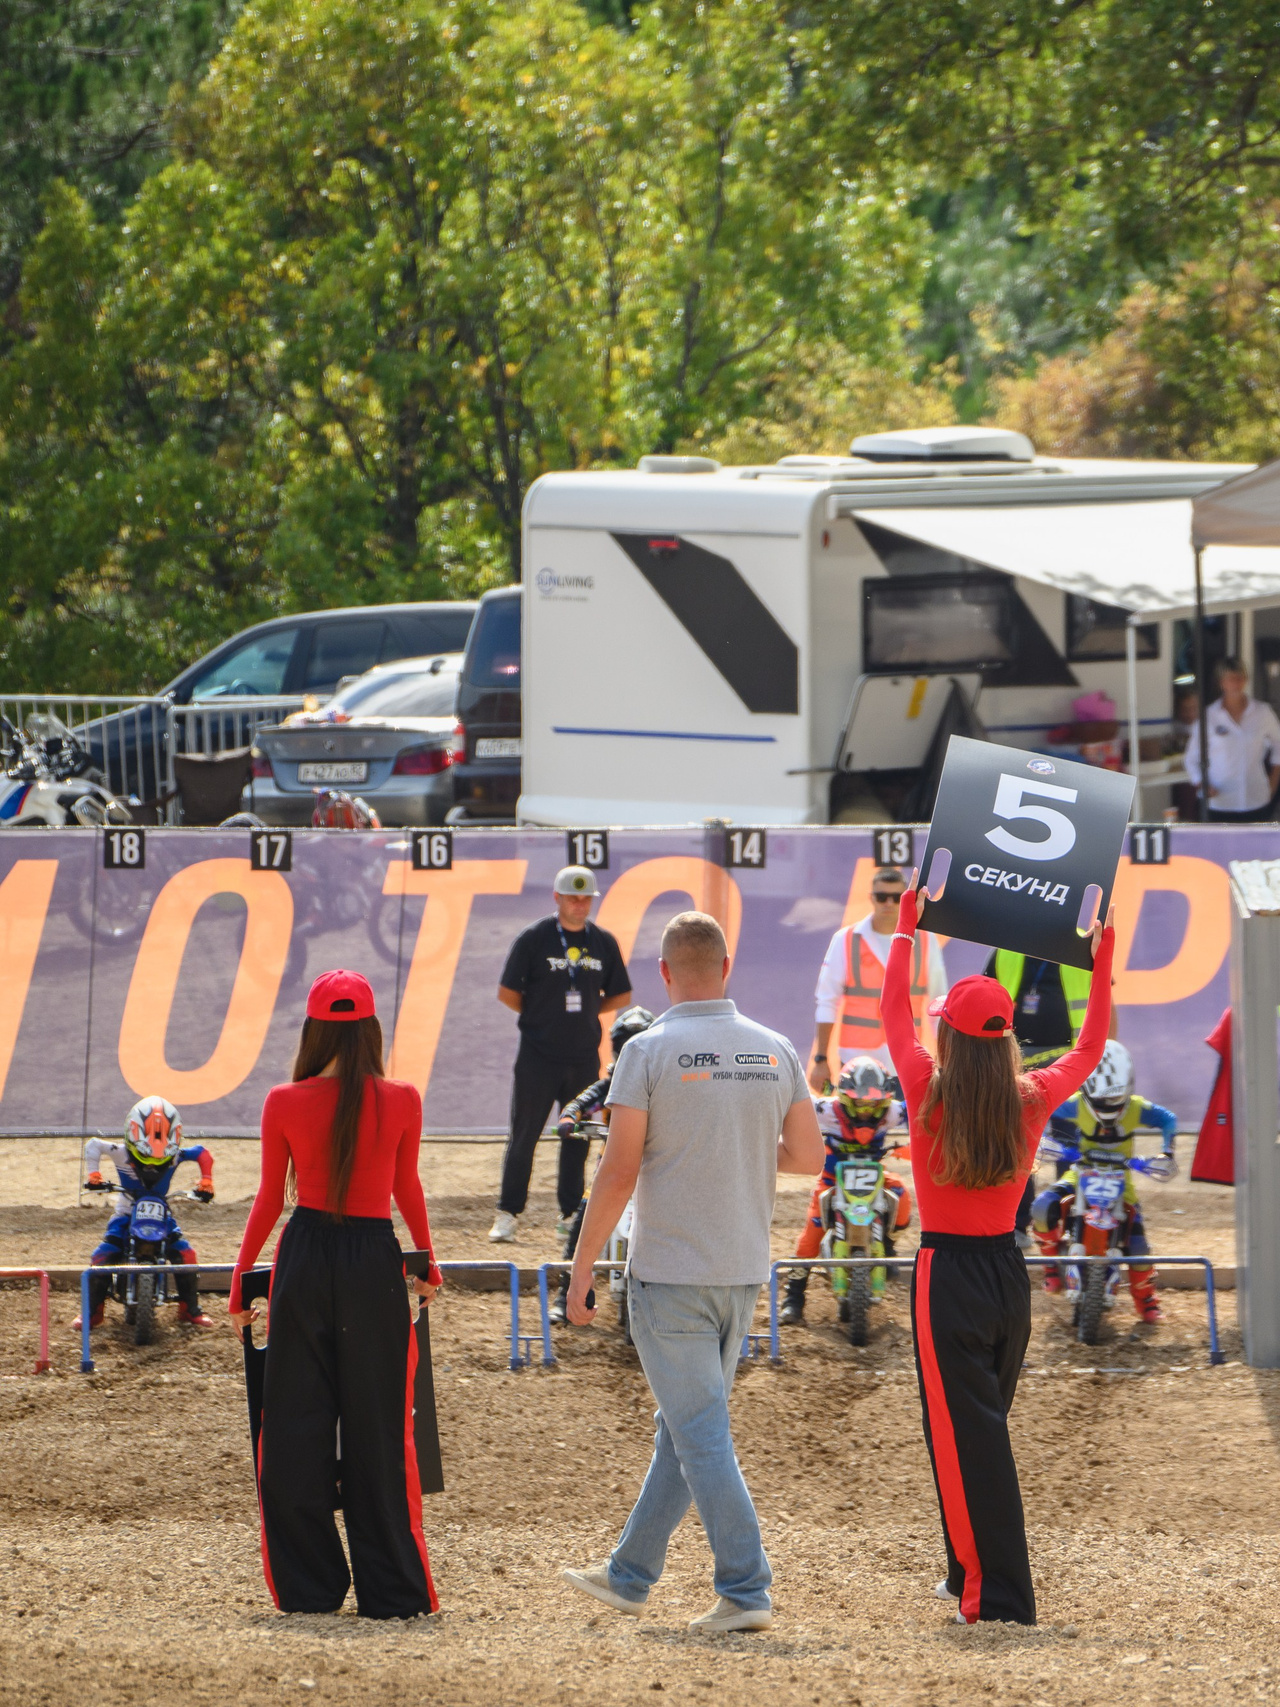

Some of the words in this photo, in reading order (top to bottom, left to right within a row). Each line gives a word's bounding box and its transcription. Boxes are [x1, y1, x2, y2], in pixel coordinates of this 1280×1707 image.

[984, 773, 1078, 860] 5
[110, 833, 140, 864] 18
[256, 835, 287, 867] 17
[417, 834, 448, 867] 16
[573, 833, 604, 866] 15
[730, 831, 762, 864] 14
[877, 831, 910, 864] 13
[1134, 829, 1164, 862] 11
[964, 863, 1070, 906] СЕКУНД
[737, 1054, 768, 1065] Winline
[712, 1071, 733, 1081] КУБОК
[734, 1072, 779, 1082] СОДРУЖЕСТВА
[843, 1168, 878, 1190] 12
[1083, 1176, 1123, 1198] 25
[137, 1203, 164, 1216] 471
